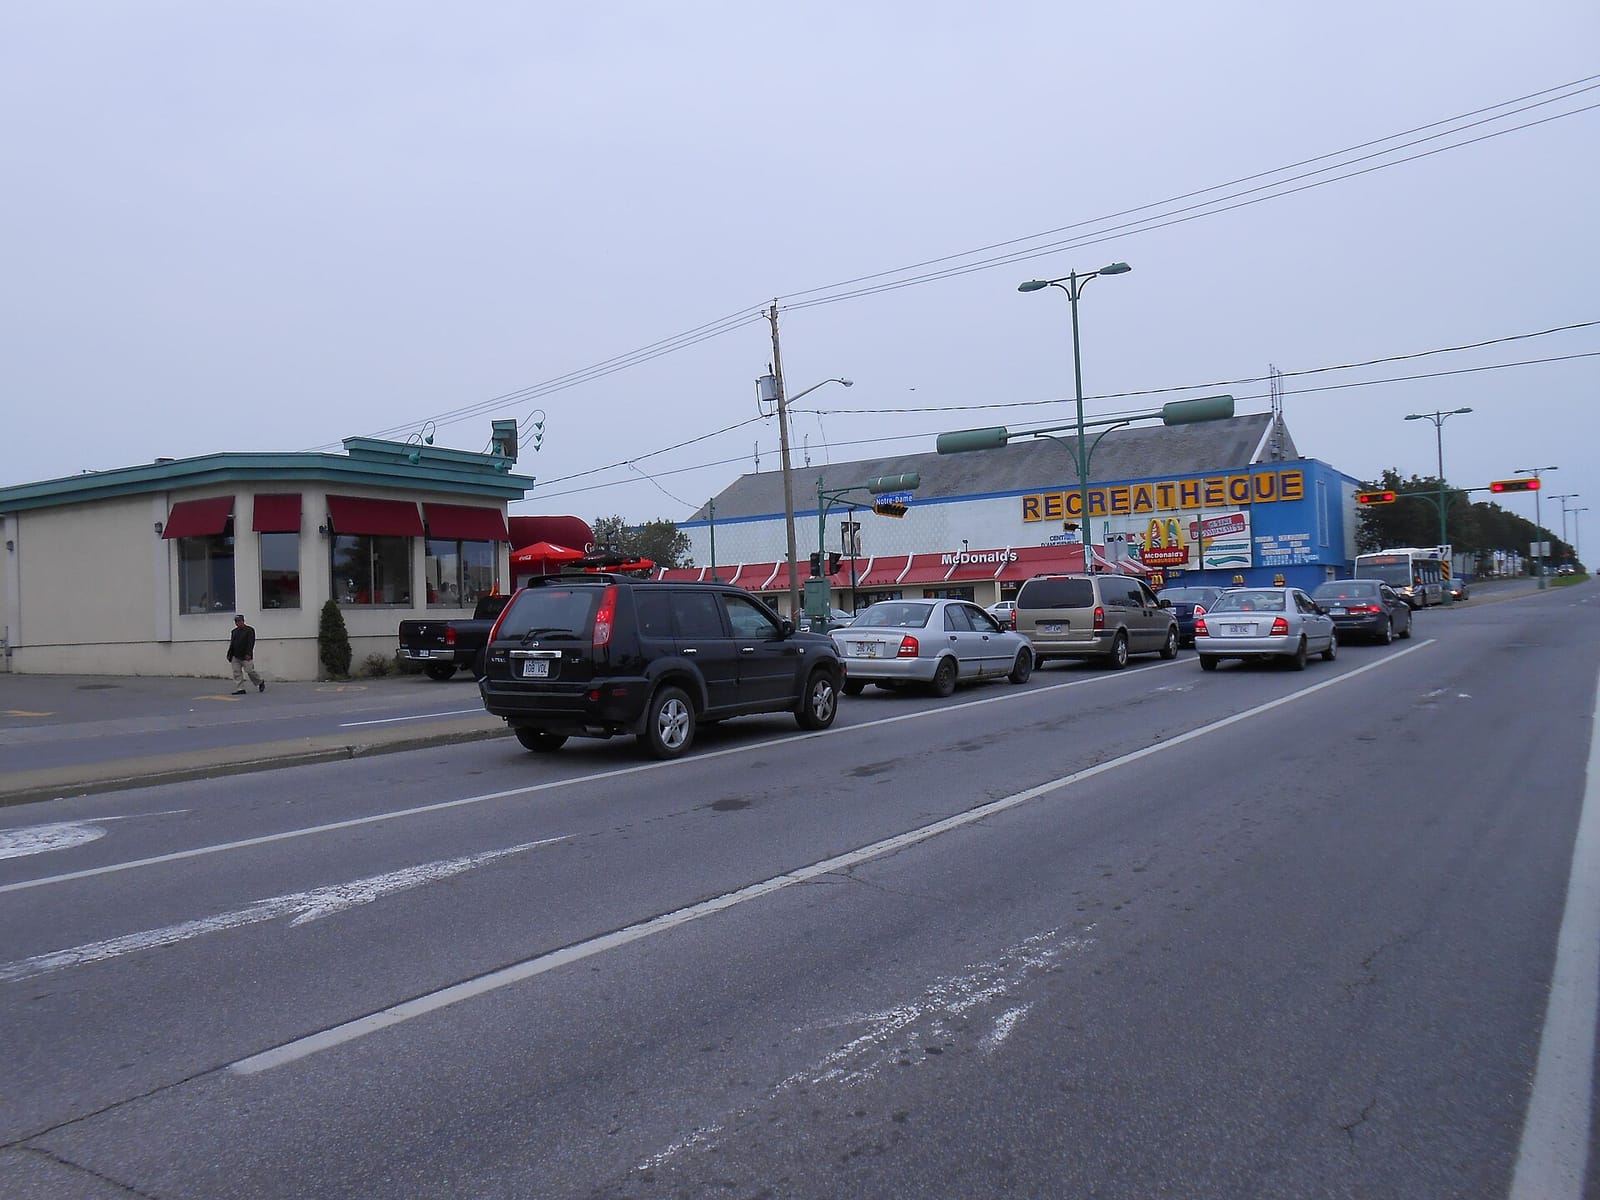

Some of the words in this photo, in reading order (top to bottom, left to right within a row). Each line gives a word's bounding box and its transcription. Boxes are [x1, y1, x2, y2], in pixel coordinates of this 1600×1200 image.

[876, 495, 914, 505] Notre-Dame
[1022, 472, 1302, 520] RECREATHEQUE
[941, 551, 1018, 566] McDonald's
[1144, 551, 1184, 559] McDonald's
